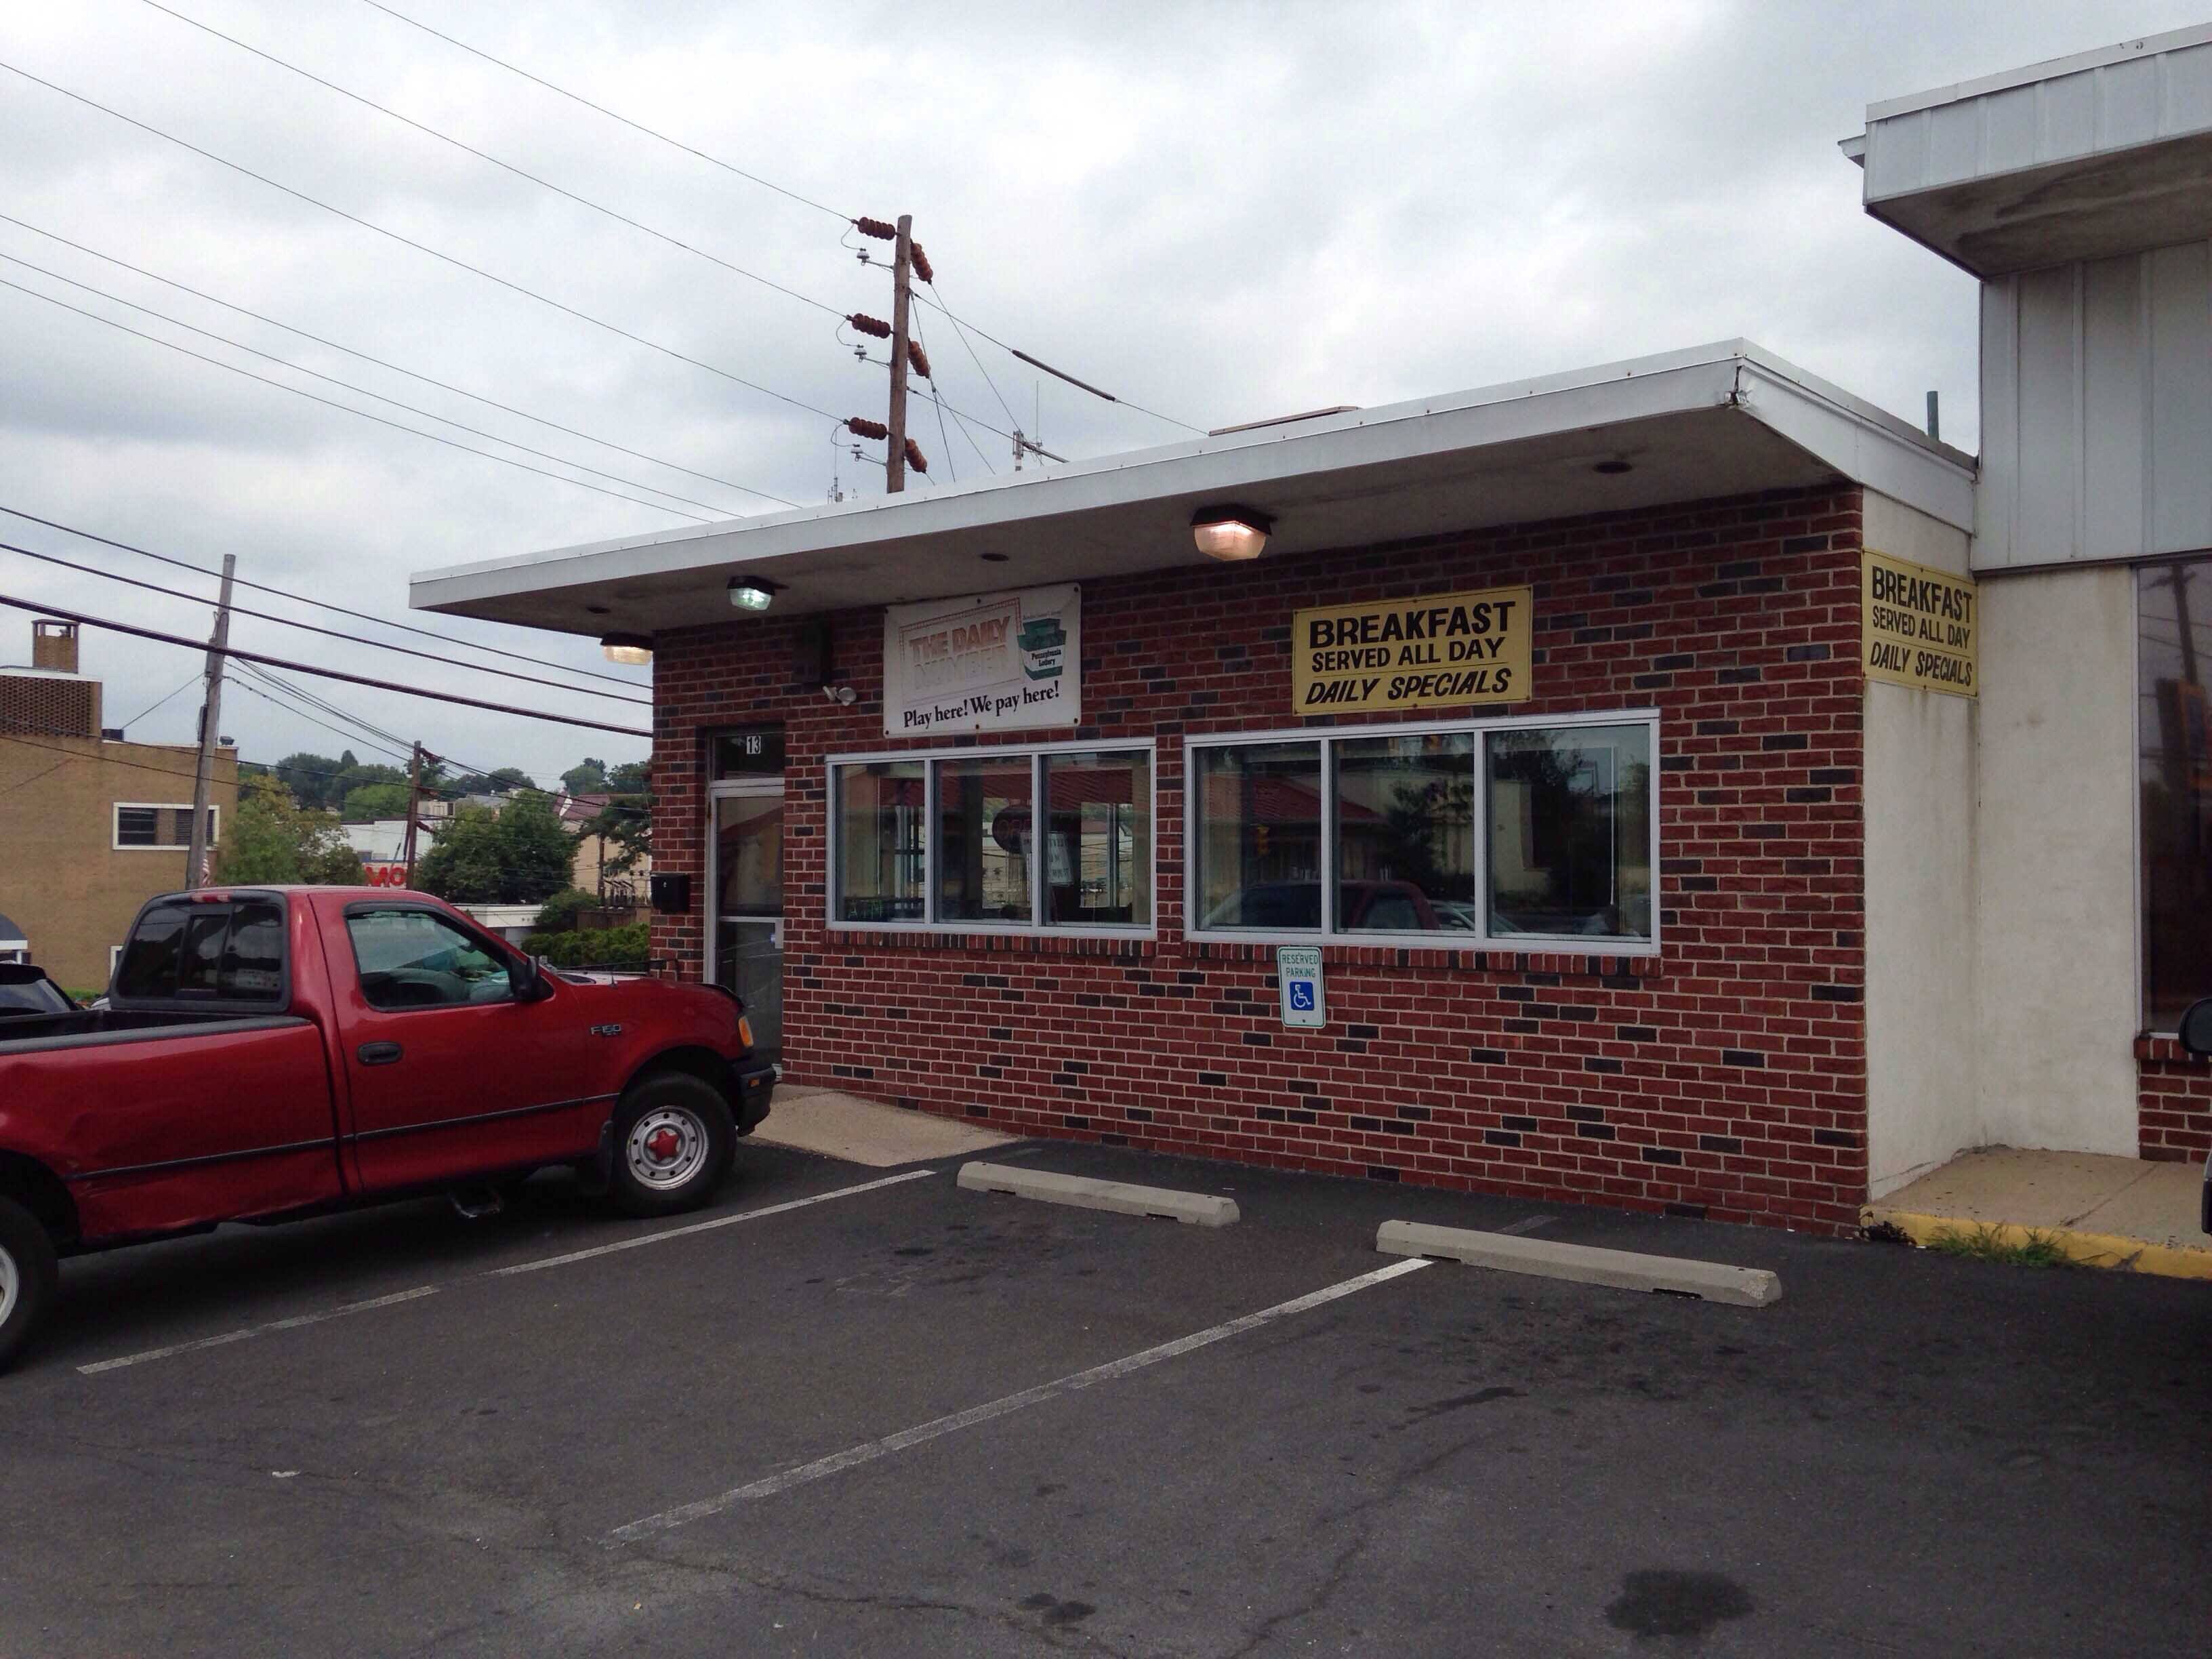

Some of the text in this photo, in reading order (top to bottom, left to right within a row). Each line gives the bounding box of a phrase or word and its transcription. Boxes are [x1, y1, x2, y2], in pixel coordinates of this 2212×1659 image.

[1872, 566, 1972, 623] BREAKFAST
[909, 615, 1011, 662] THE DAILY
[1309, 601, 1515, 649] BREAKFAST
[1872, 605, 1971, 649] SERVED ALL DAY
[1311, 636, 1505, 672] SERVED ALL DAY
[1870, 642, 1972, 687] DAILY SPECIALS
[903, 680, 1059, 729] Play here! We pay here!
[1305, 668, 1512, 705] DAILY SPECIALS
[747, 736, 760, 754] 13
[1282, 954, 1319, 965] RESERVED
[1286, 967, 1316, 977] PARKING
